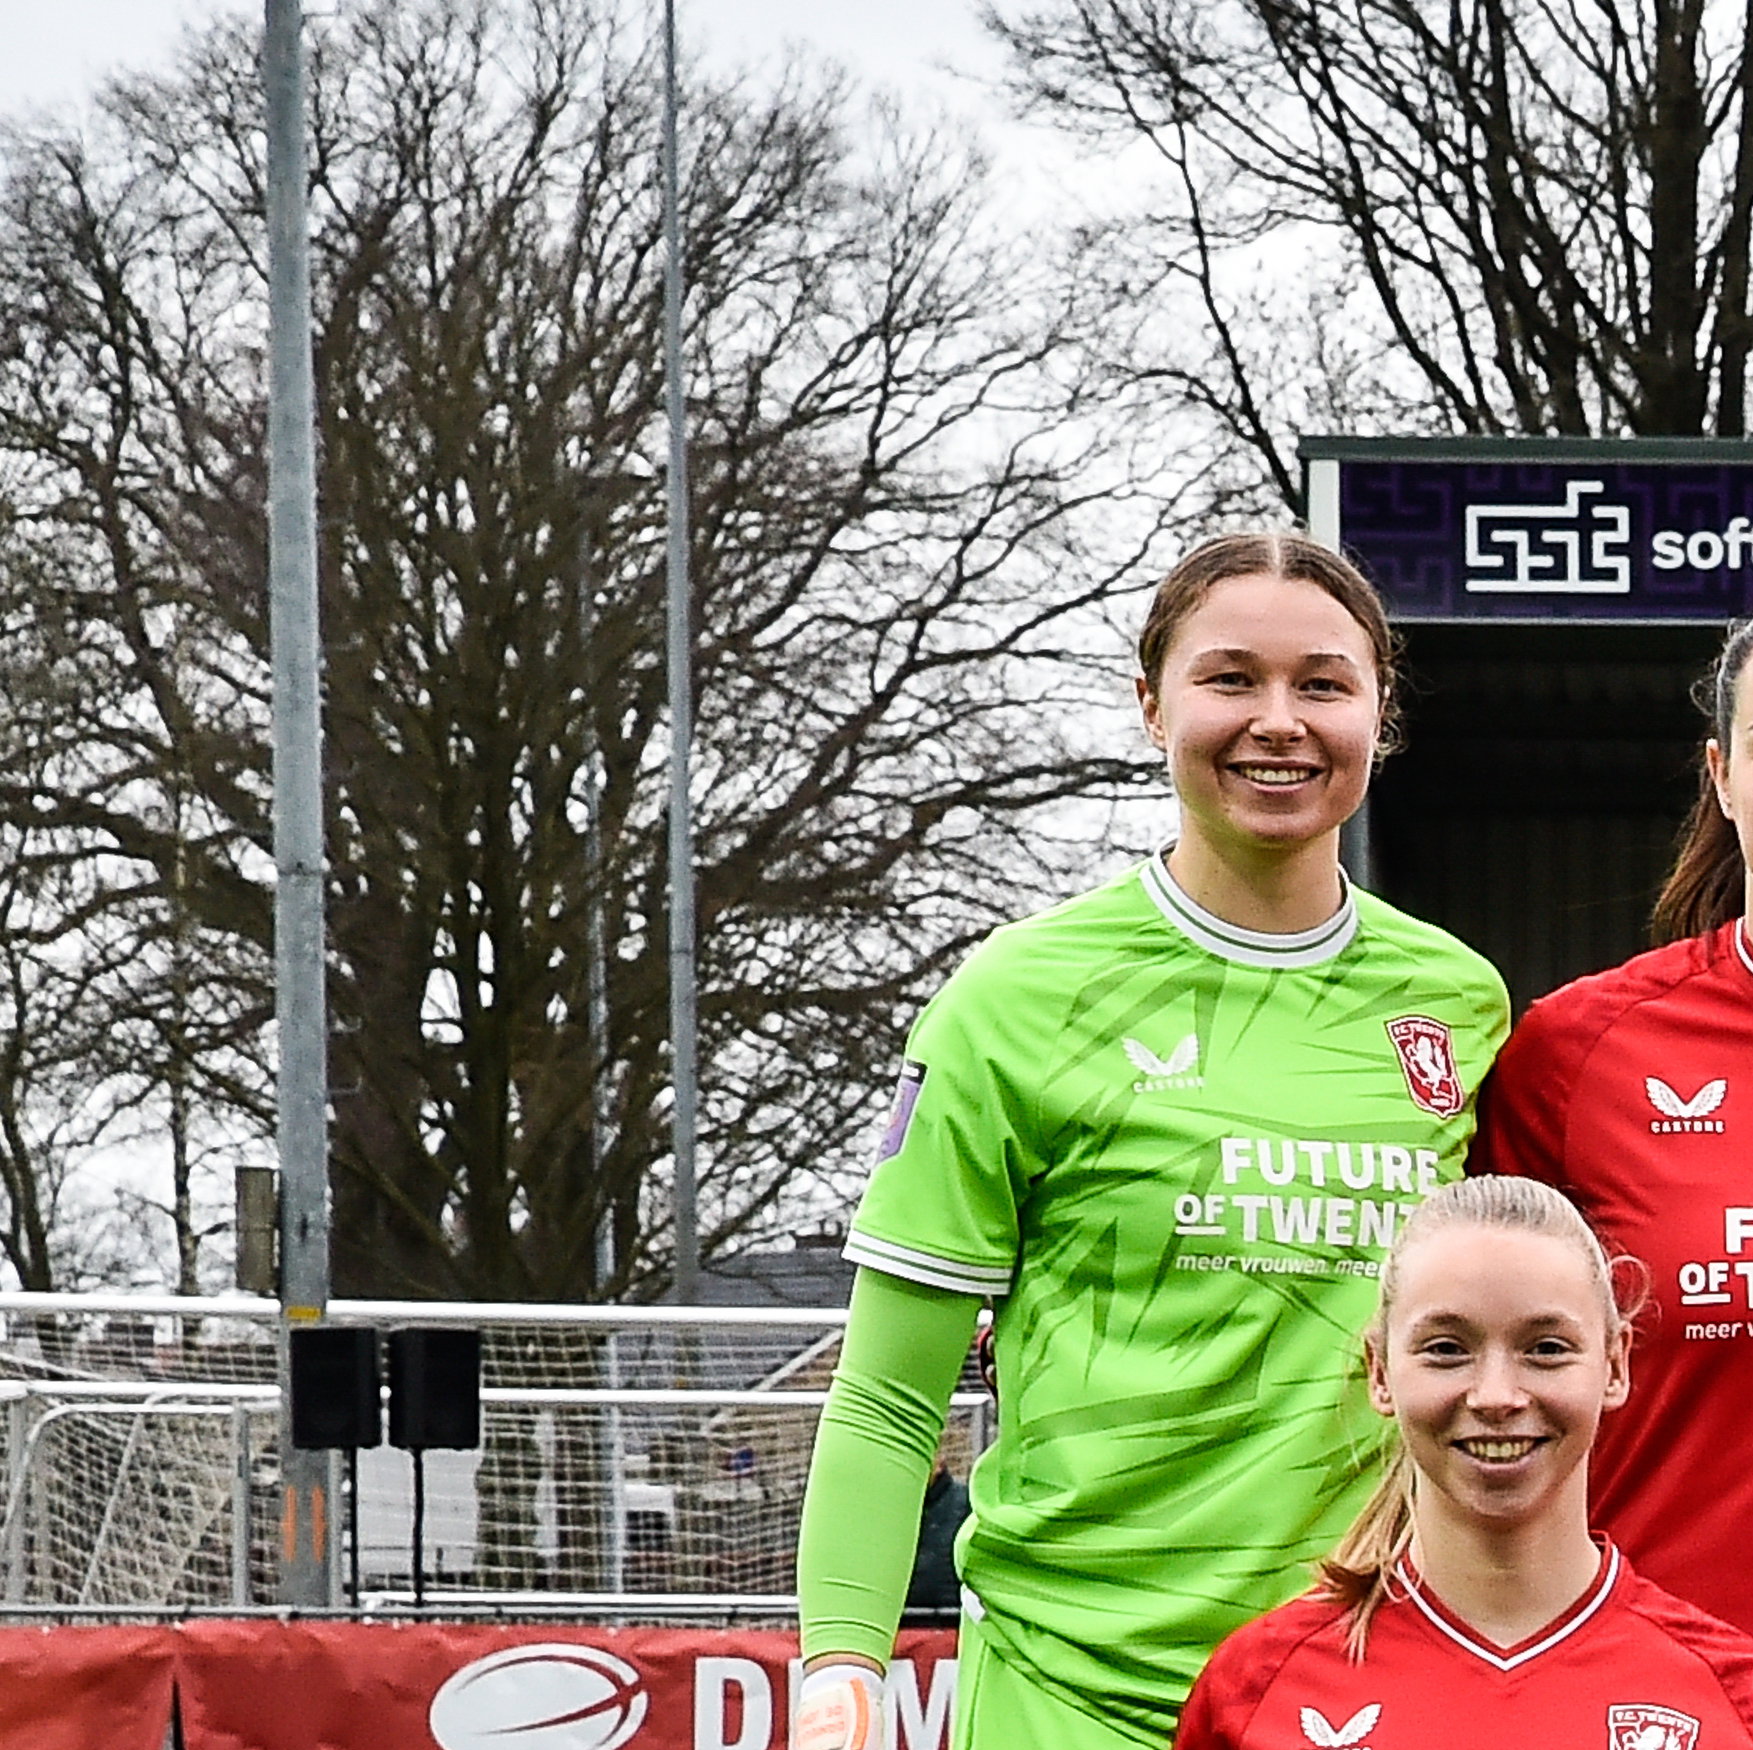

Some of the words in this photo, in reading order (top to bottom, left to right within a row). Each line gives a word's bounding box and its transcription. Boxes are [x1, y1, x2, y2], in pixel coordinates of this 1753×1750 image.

[1222, 1137, 1440, 1196] FUTURE
[1174, 1193, 1226, 1234] OF
[1232, 1193, 1415, 1249] TWEN
[1175, 1254, 1235, 1273] meer
[1678, 1261, 1731, 1305] OF
[1684, 1321, 1742, 1340] meer
